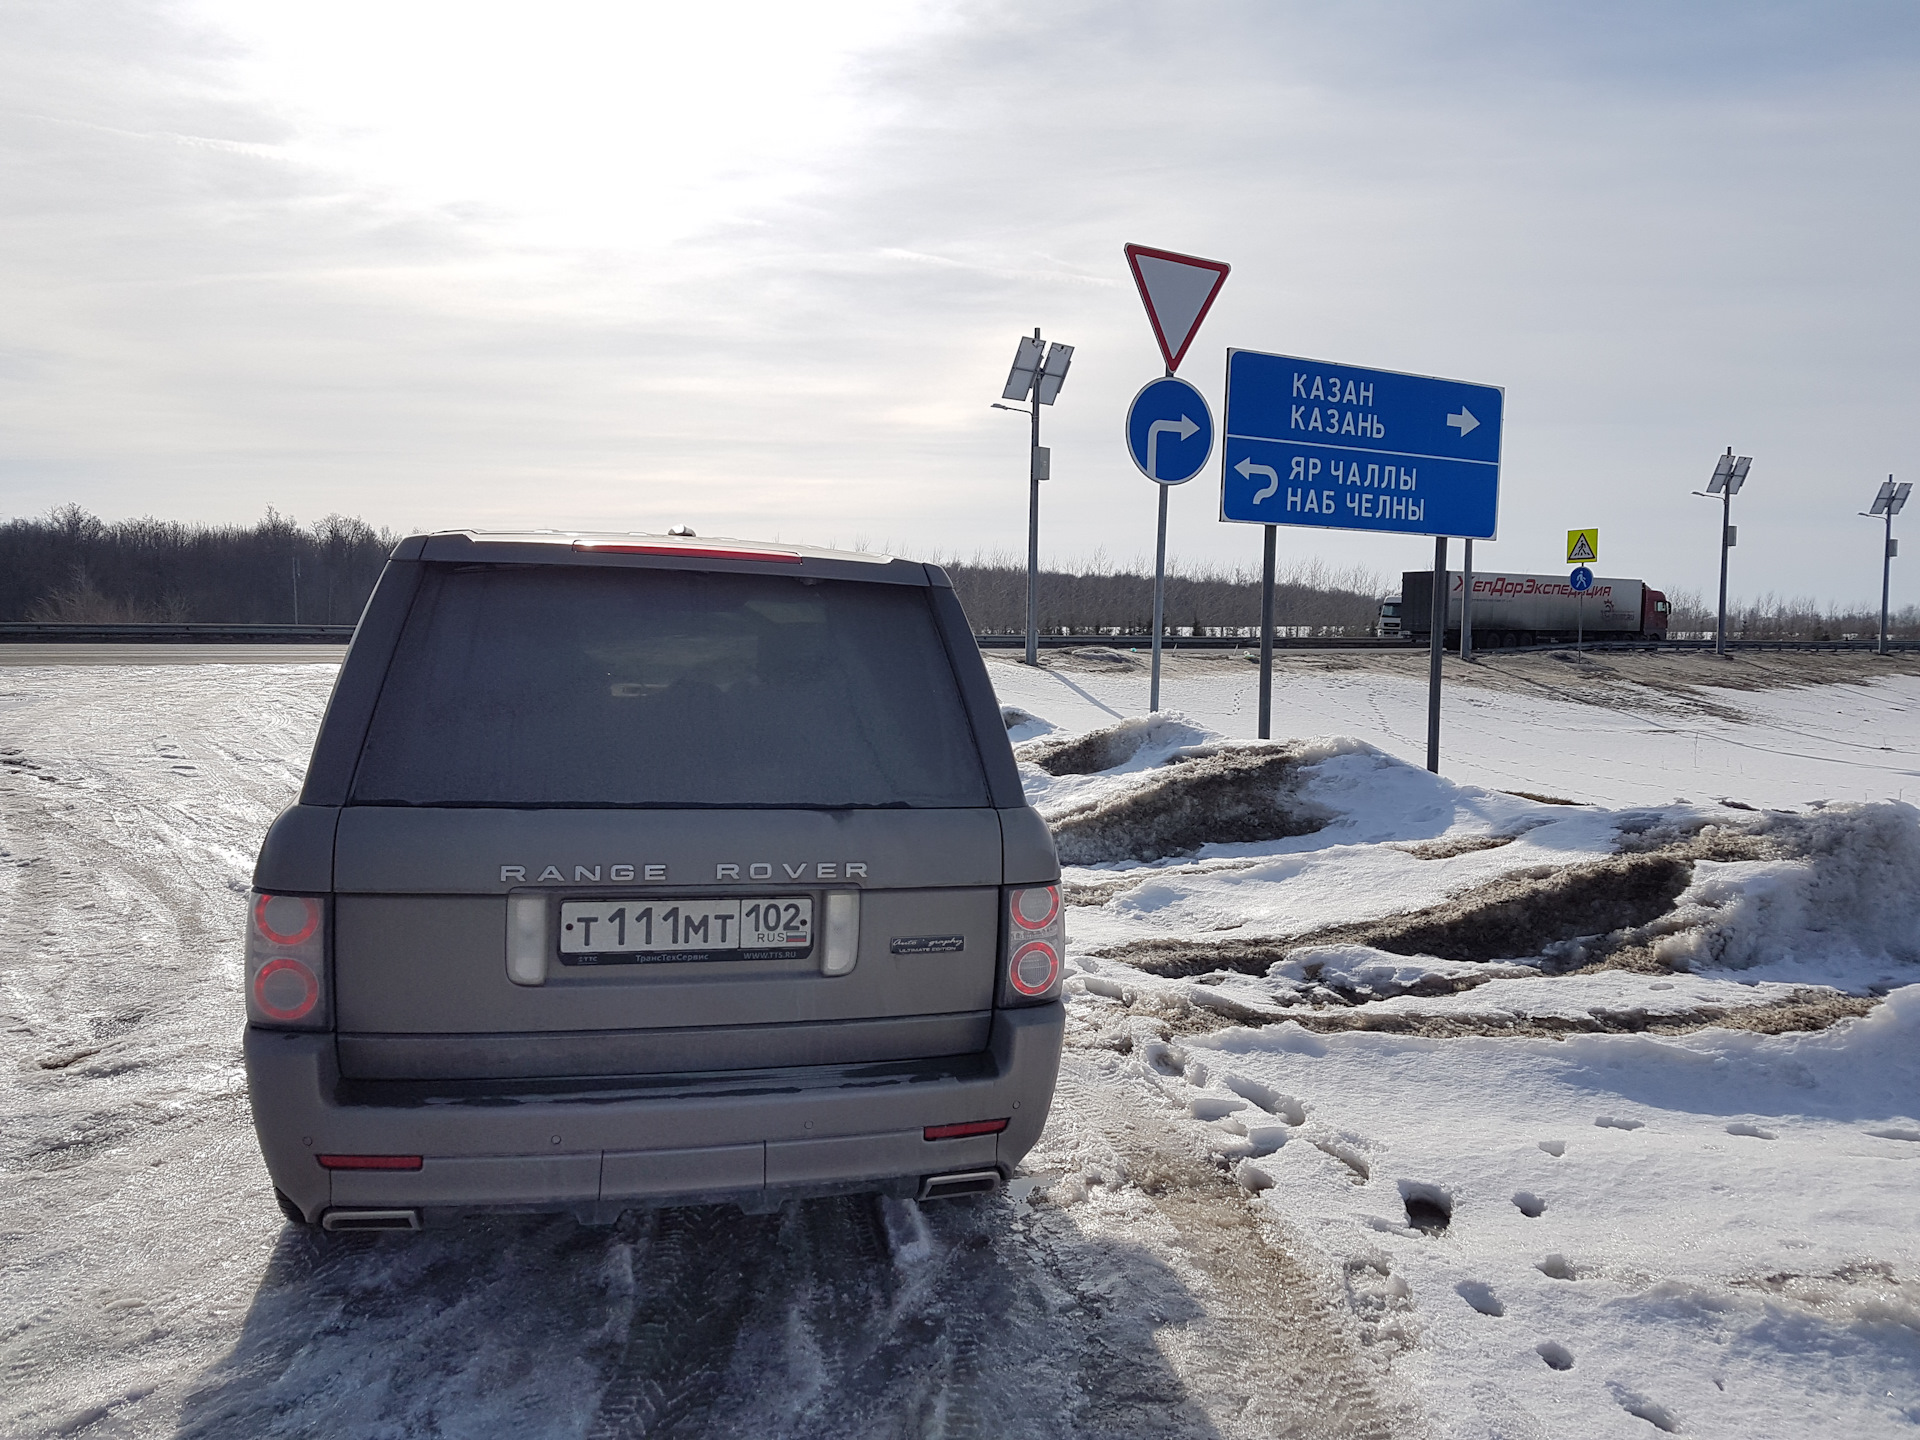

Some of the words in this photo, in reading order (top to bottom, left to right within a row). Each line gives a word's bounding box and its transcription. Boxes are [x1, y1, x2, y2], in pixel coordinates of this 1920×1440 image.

[1292, 372, 1374, 407] КАЗАН
[1290, 404, 1386, 439] КАЗАНЬ
[1288, 456, 1322, 482] ЯР
[1330, 459, 1417, 491] ЧАЛЛЫ
[1286, 487, 1336, 514] НАБ
[1346, 492, 1425, 521] ЧЕЛНЫ
[500, 864, 667, 882] RANGE
[716, 862, 868, 880] ROVER
[745, 903, 801, 932] 102
[757, 933, 785, 943] RUS
[635, 953, 709, 963] ТрансТехСервис
[743, 951, 797, 960] WWW.TTS.RU
